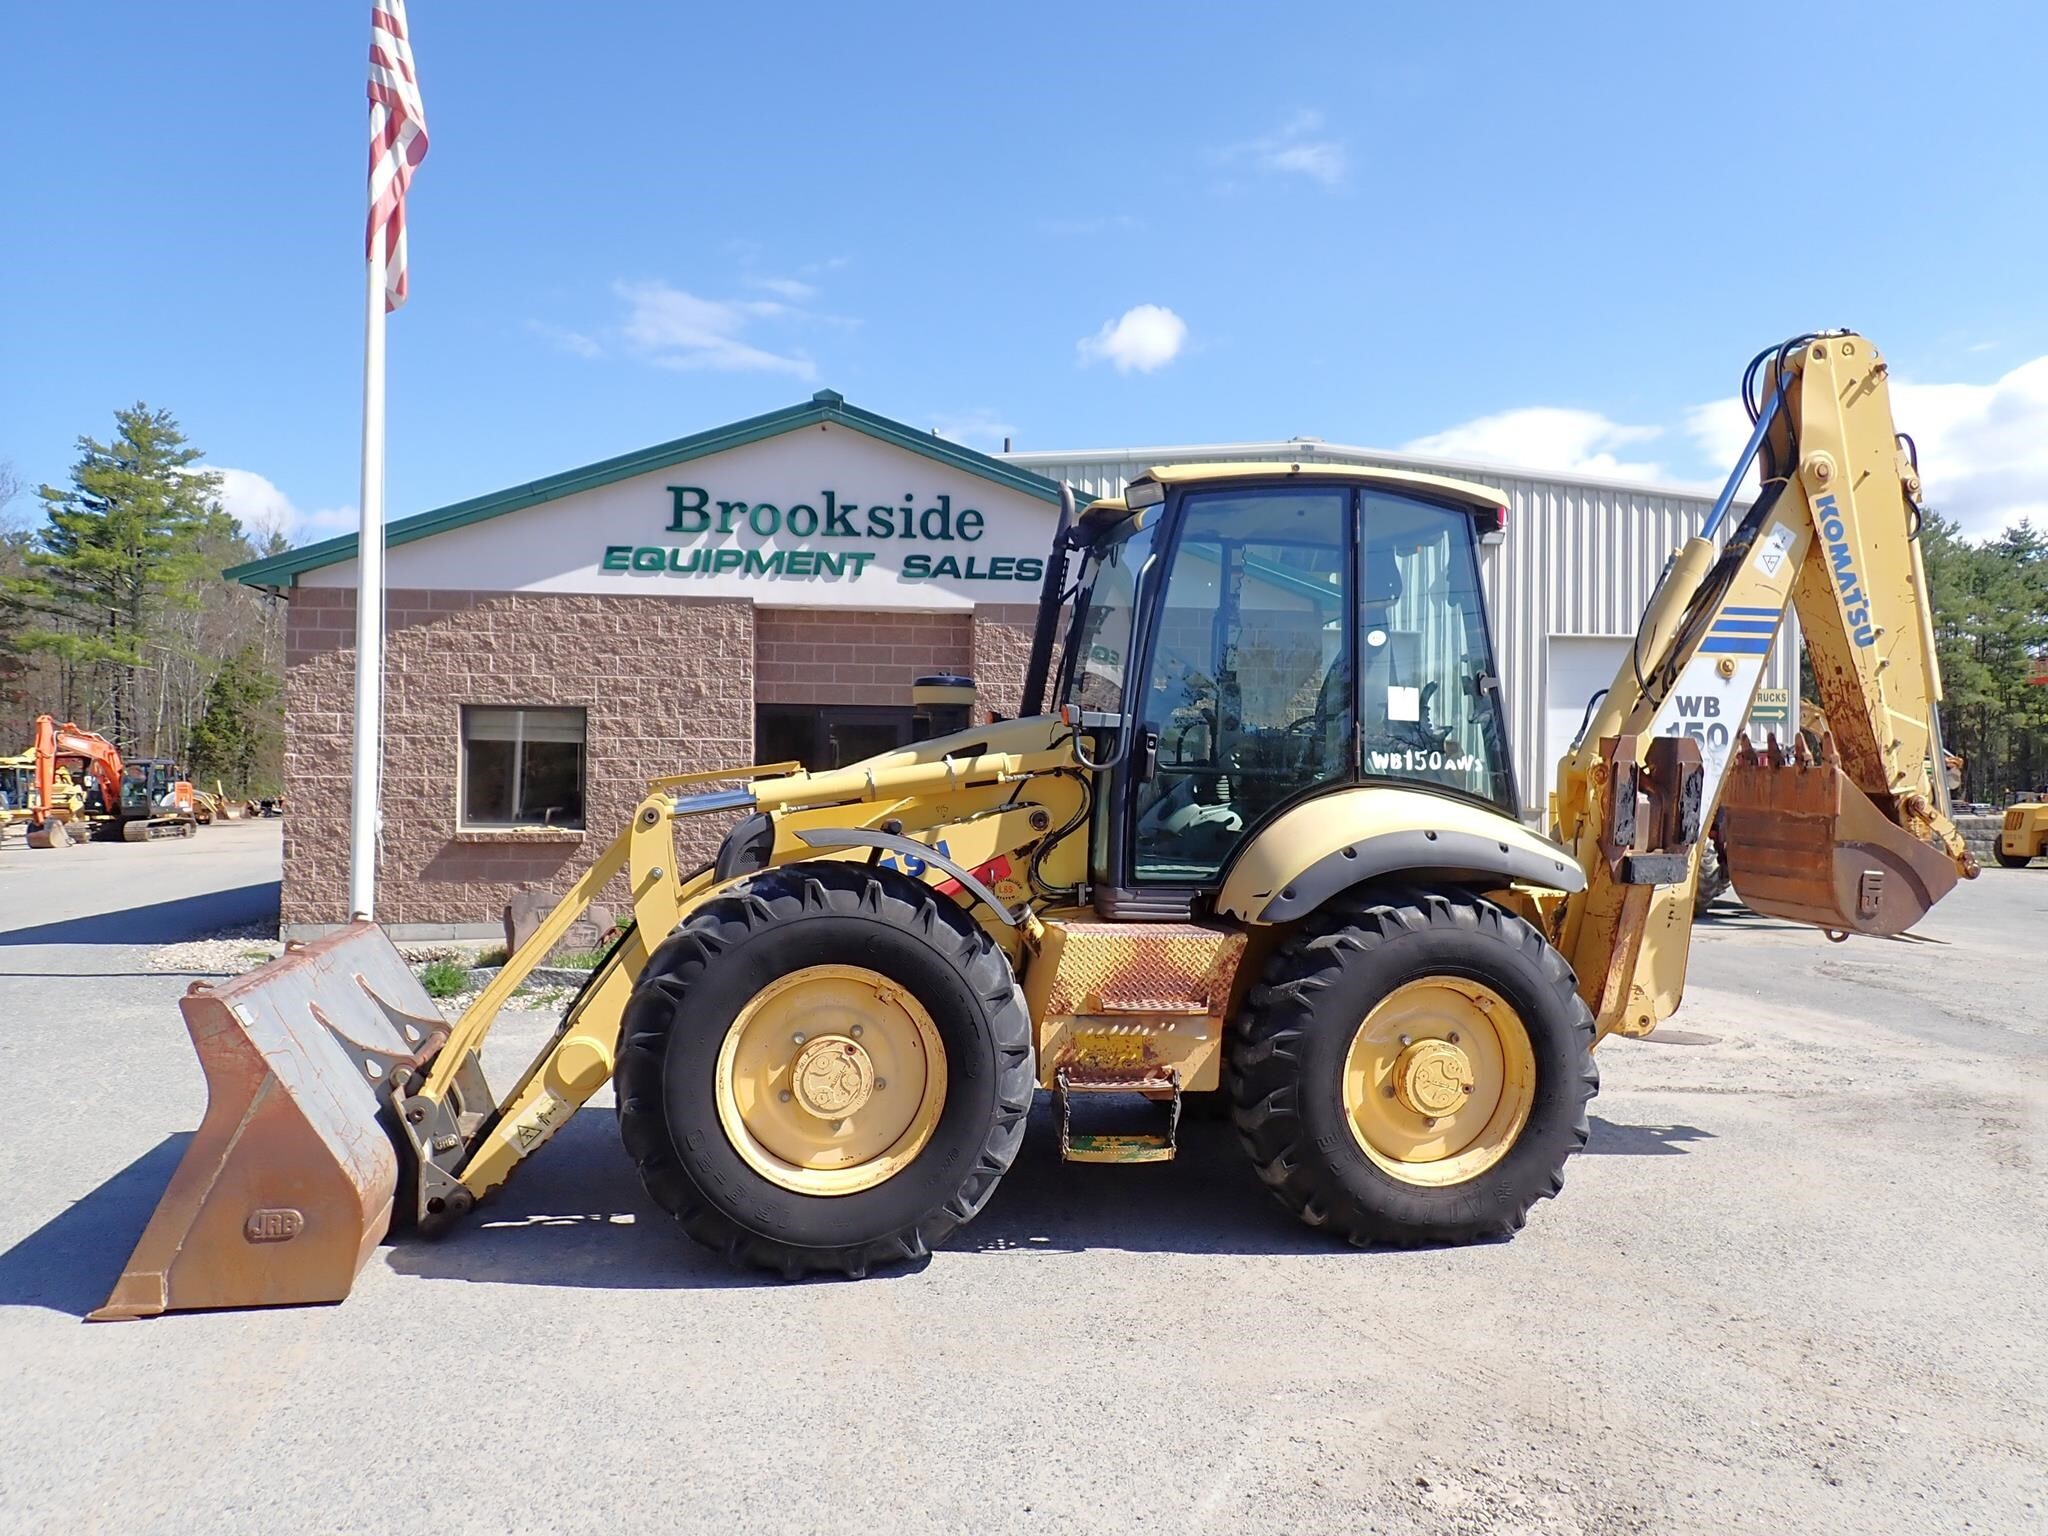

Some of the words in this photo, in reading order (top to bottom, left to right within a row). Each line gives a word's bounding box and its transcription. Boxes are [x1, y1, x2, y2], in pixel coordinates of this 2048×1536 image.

[665, 485, 985, 542] Brookside
[602, 545, 876, 577] EQUIPMENT
[902, 553, 1043, 581] SALES
[1815, 494, 1875, 649] KOMATSU
[1675, 695, 1721, 718] WB
[1757, 692, 1787, 703] RUCKS
[250, 1212, 300, 1236] JRB
